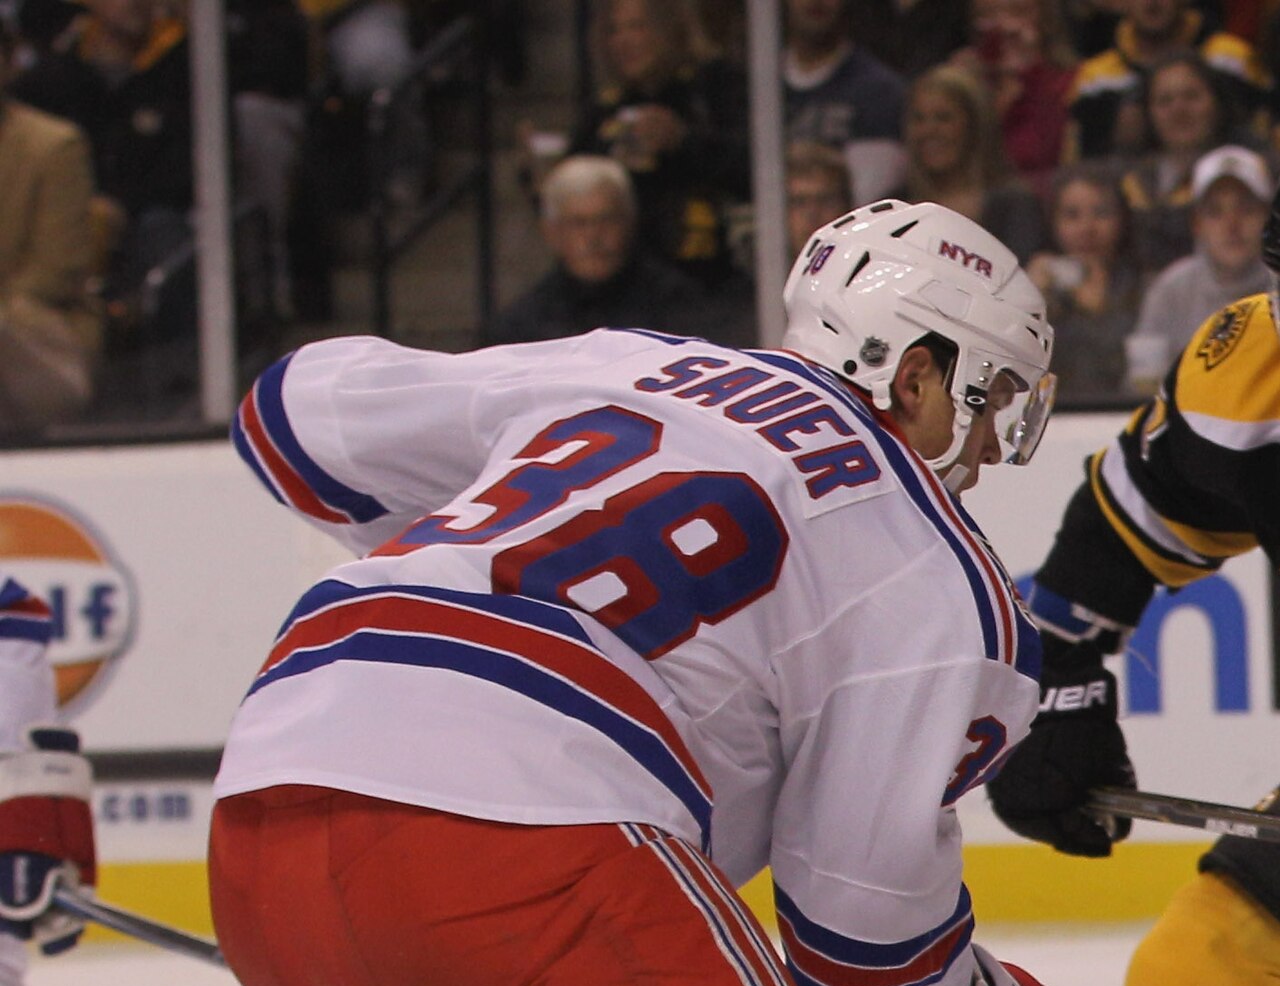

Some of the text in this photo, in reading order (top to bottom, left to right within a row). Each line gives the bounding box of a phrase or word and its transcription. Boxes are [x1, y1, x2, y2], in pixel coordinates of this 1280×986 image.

[939, 240, 993, 279] NYR
[634, 356, 882, 500] SAUER
[366, 404, 790, 661] 38
